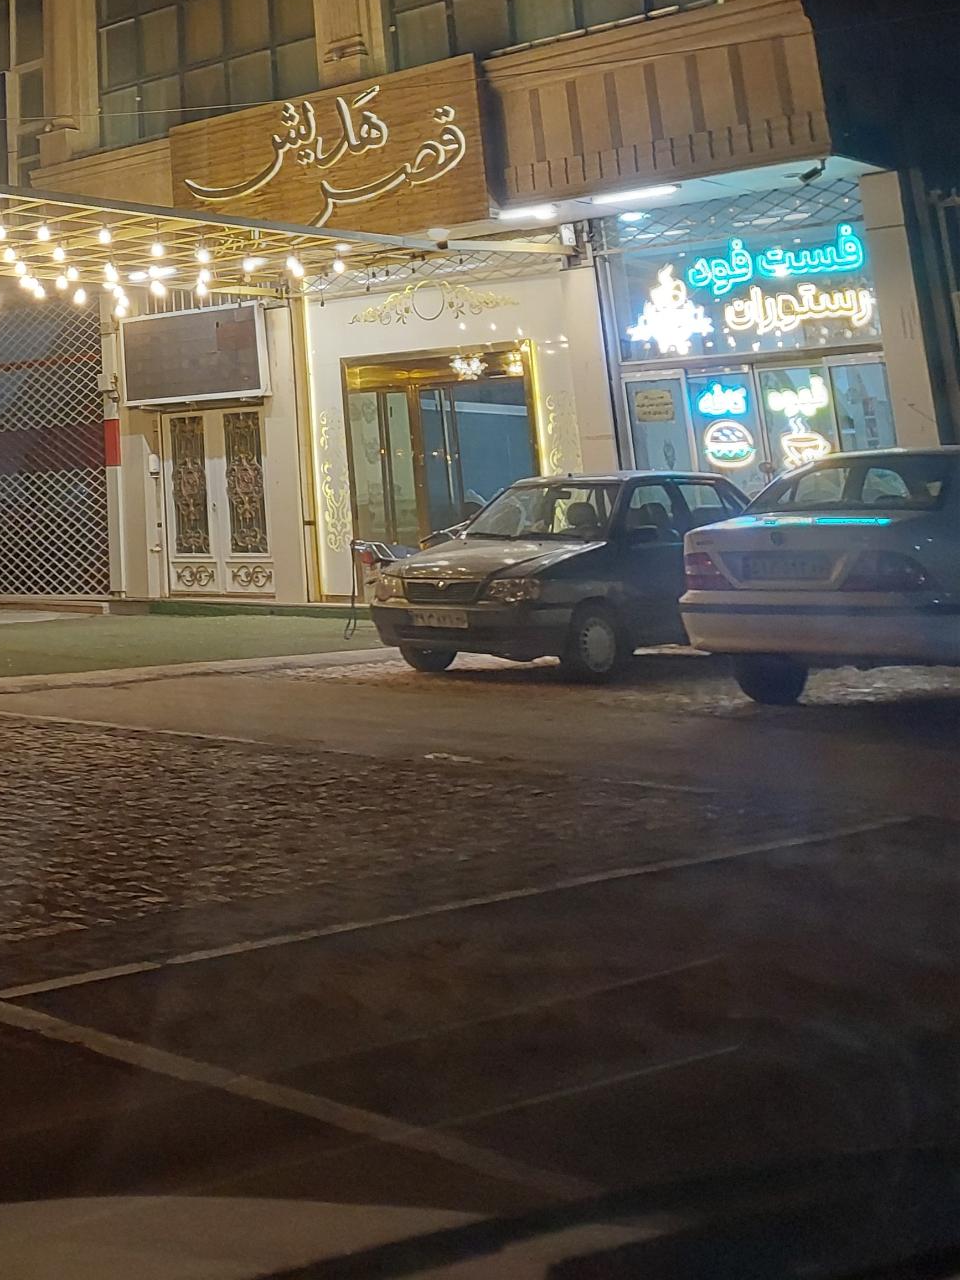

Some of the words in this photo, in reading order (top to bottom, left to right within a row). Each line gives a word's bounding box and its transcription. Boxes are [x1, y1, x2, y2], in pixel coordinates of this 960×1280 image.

[306, 105, 467, 228] قصر
[687, 238, 753, 295] فود
[756, 223, 865, 278] فست
[724, 283, 874, 333] رستوران
